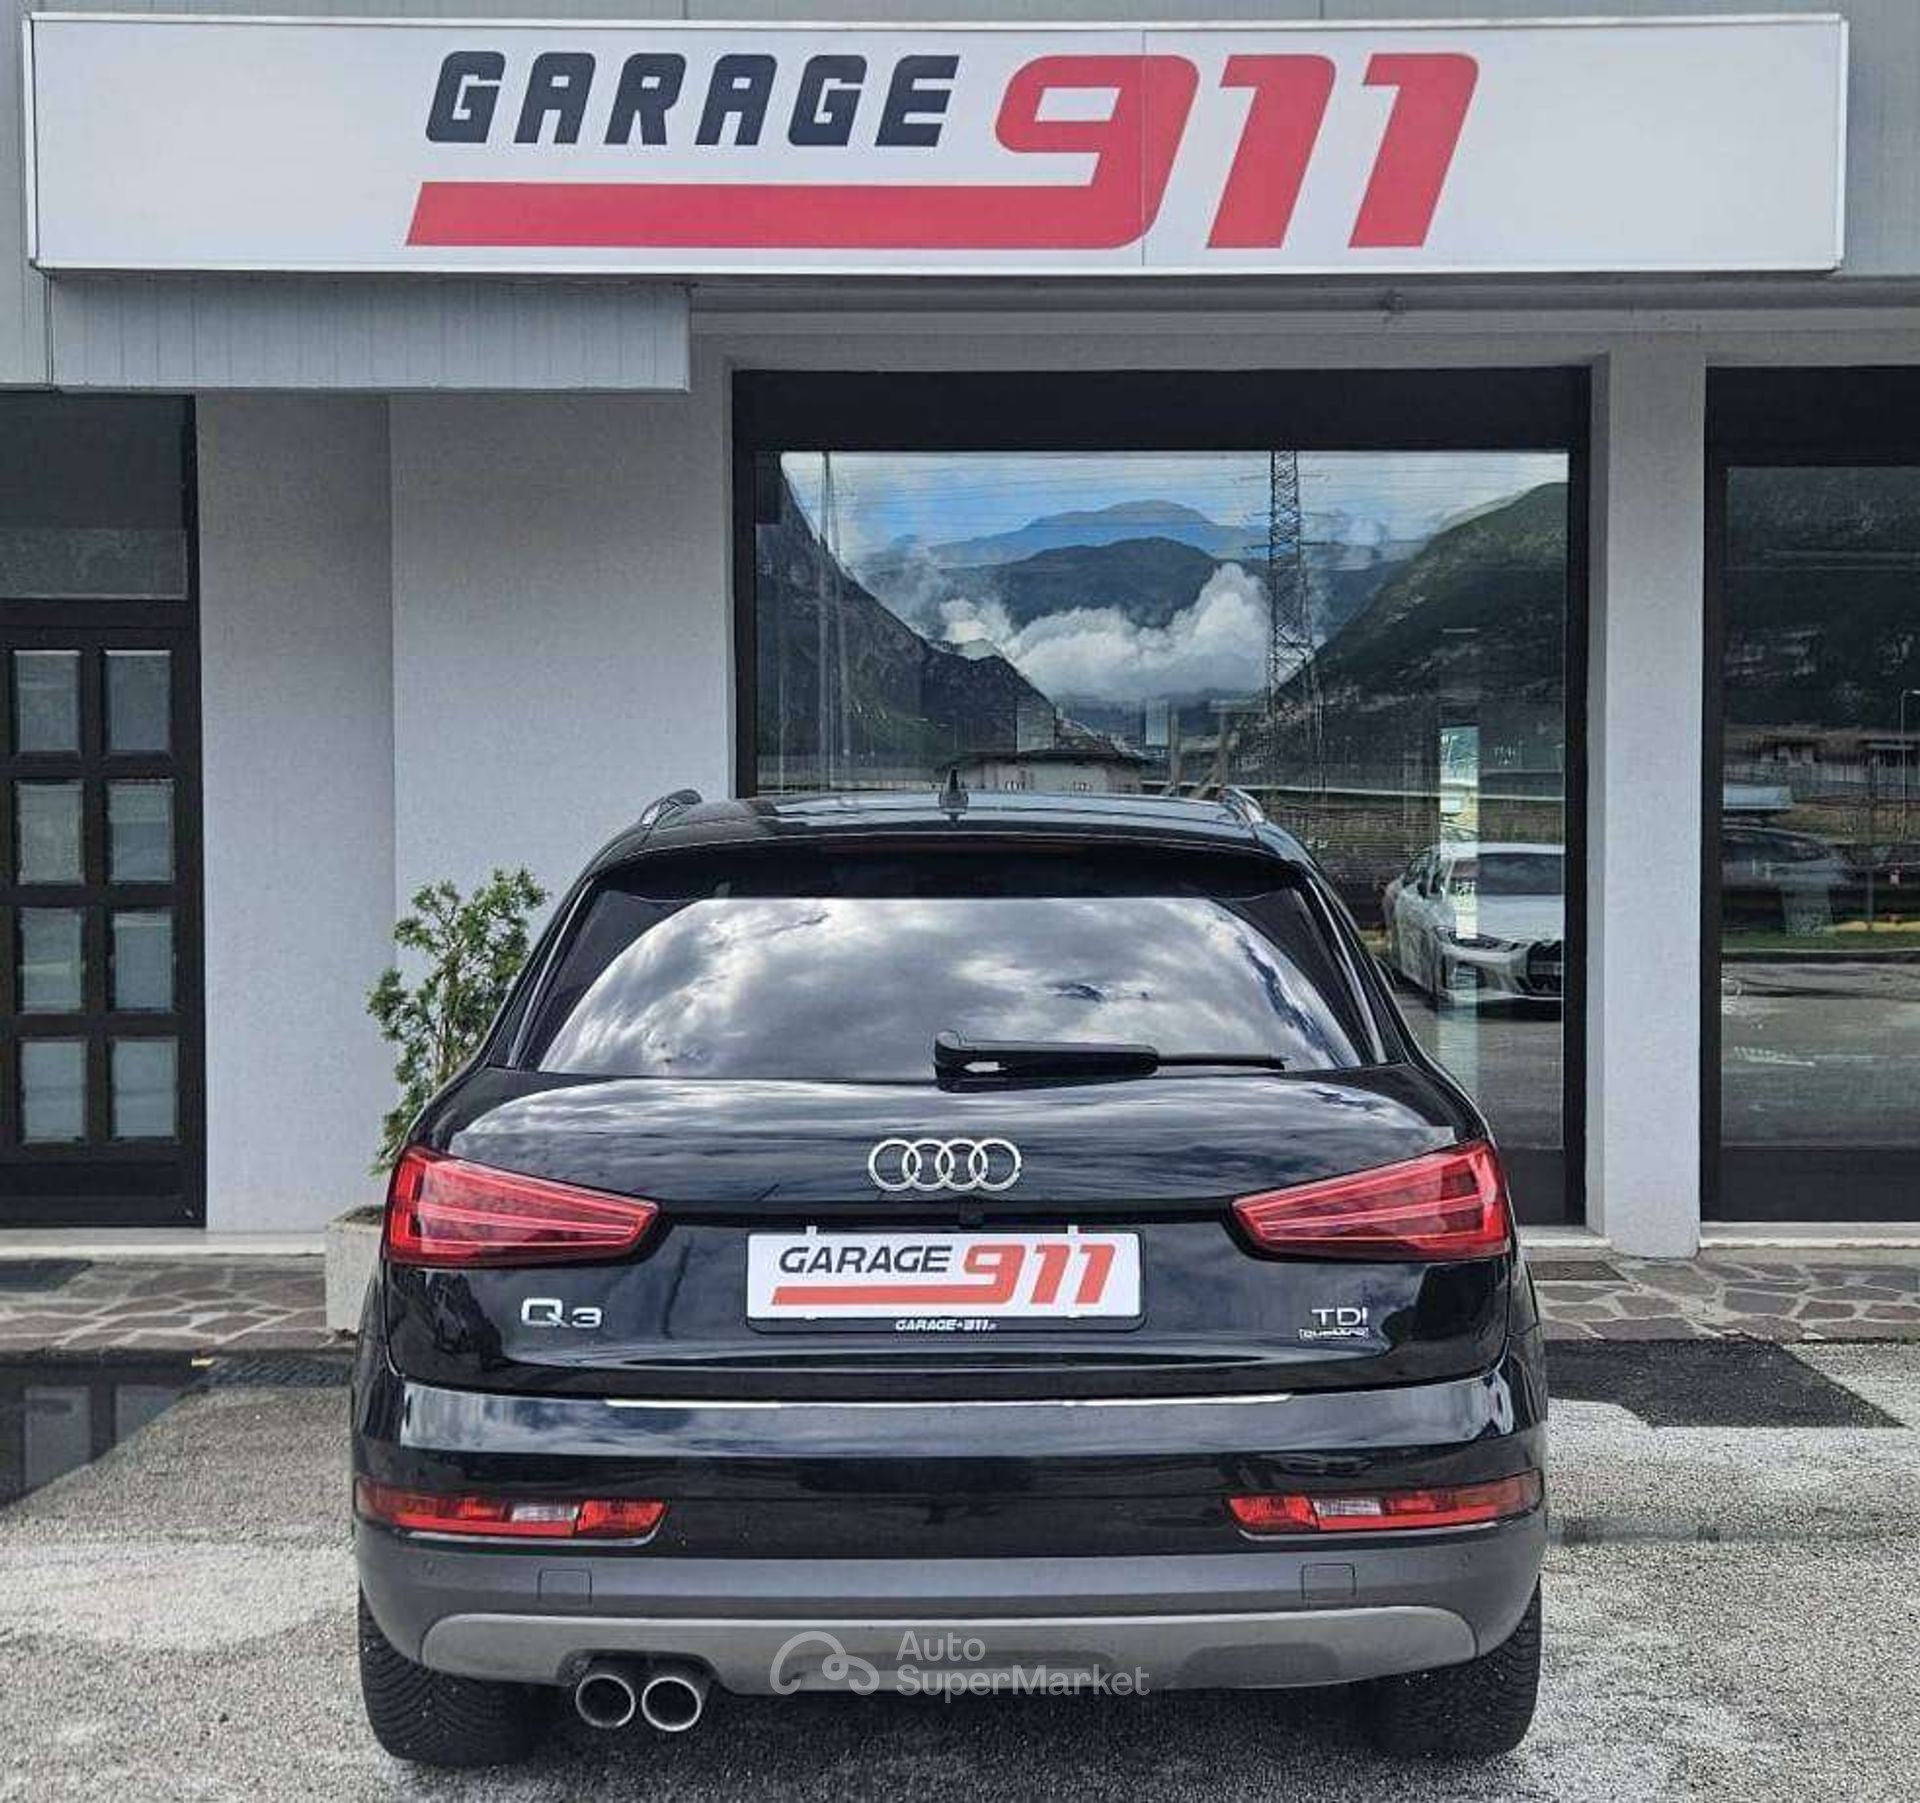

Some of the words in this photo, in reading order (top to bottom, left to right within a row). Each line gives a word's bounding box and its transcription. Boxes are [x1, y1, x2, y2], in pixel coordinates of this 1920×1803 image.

[425, 51, 959, 146] GARAGE
[994, 54, 1478, 249] 911
[778, 1245, 952, 1273] GARAGE
[963, 1243, 1115, 1304] 911
[521, 1298, 602, 1328] Q3
[1311, 1307, 1368, 1326] TDI
